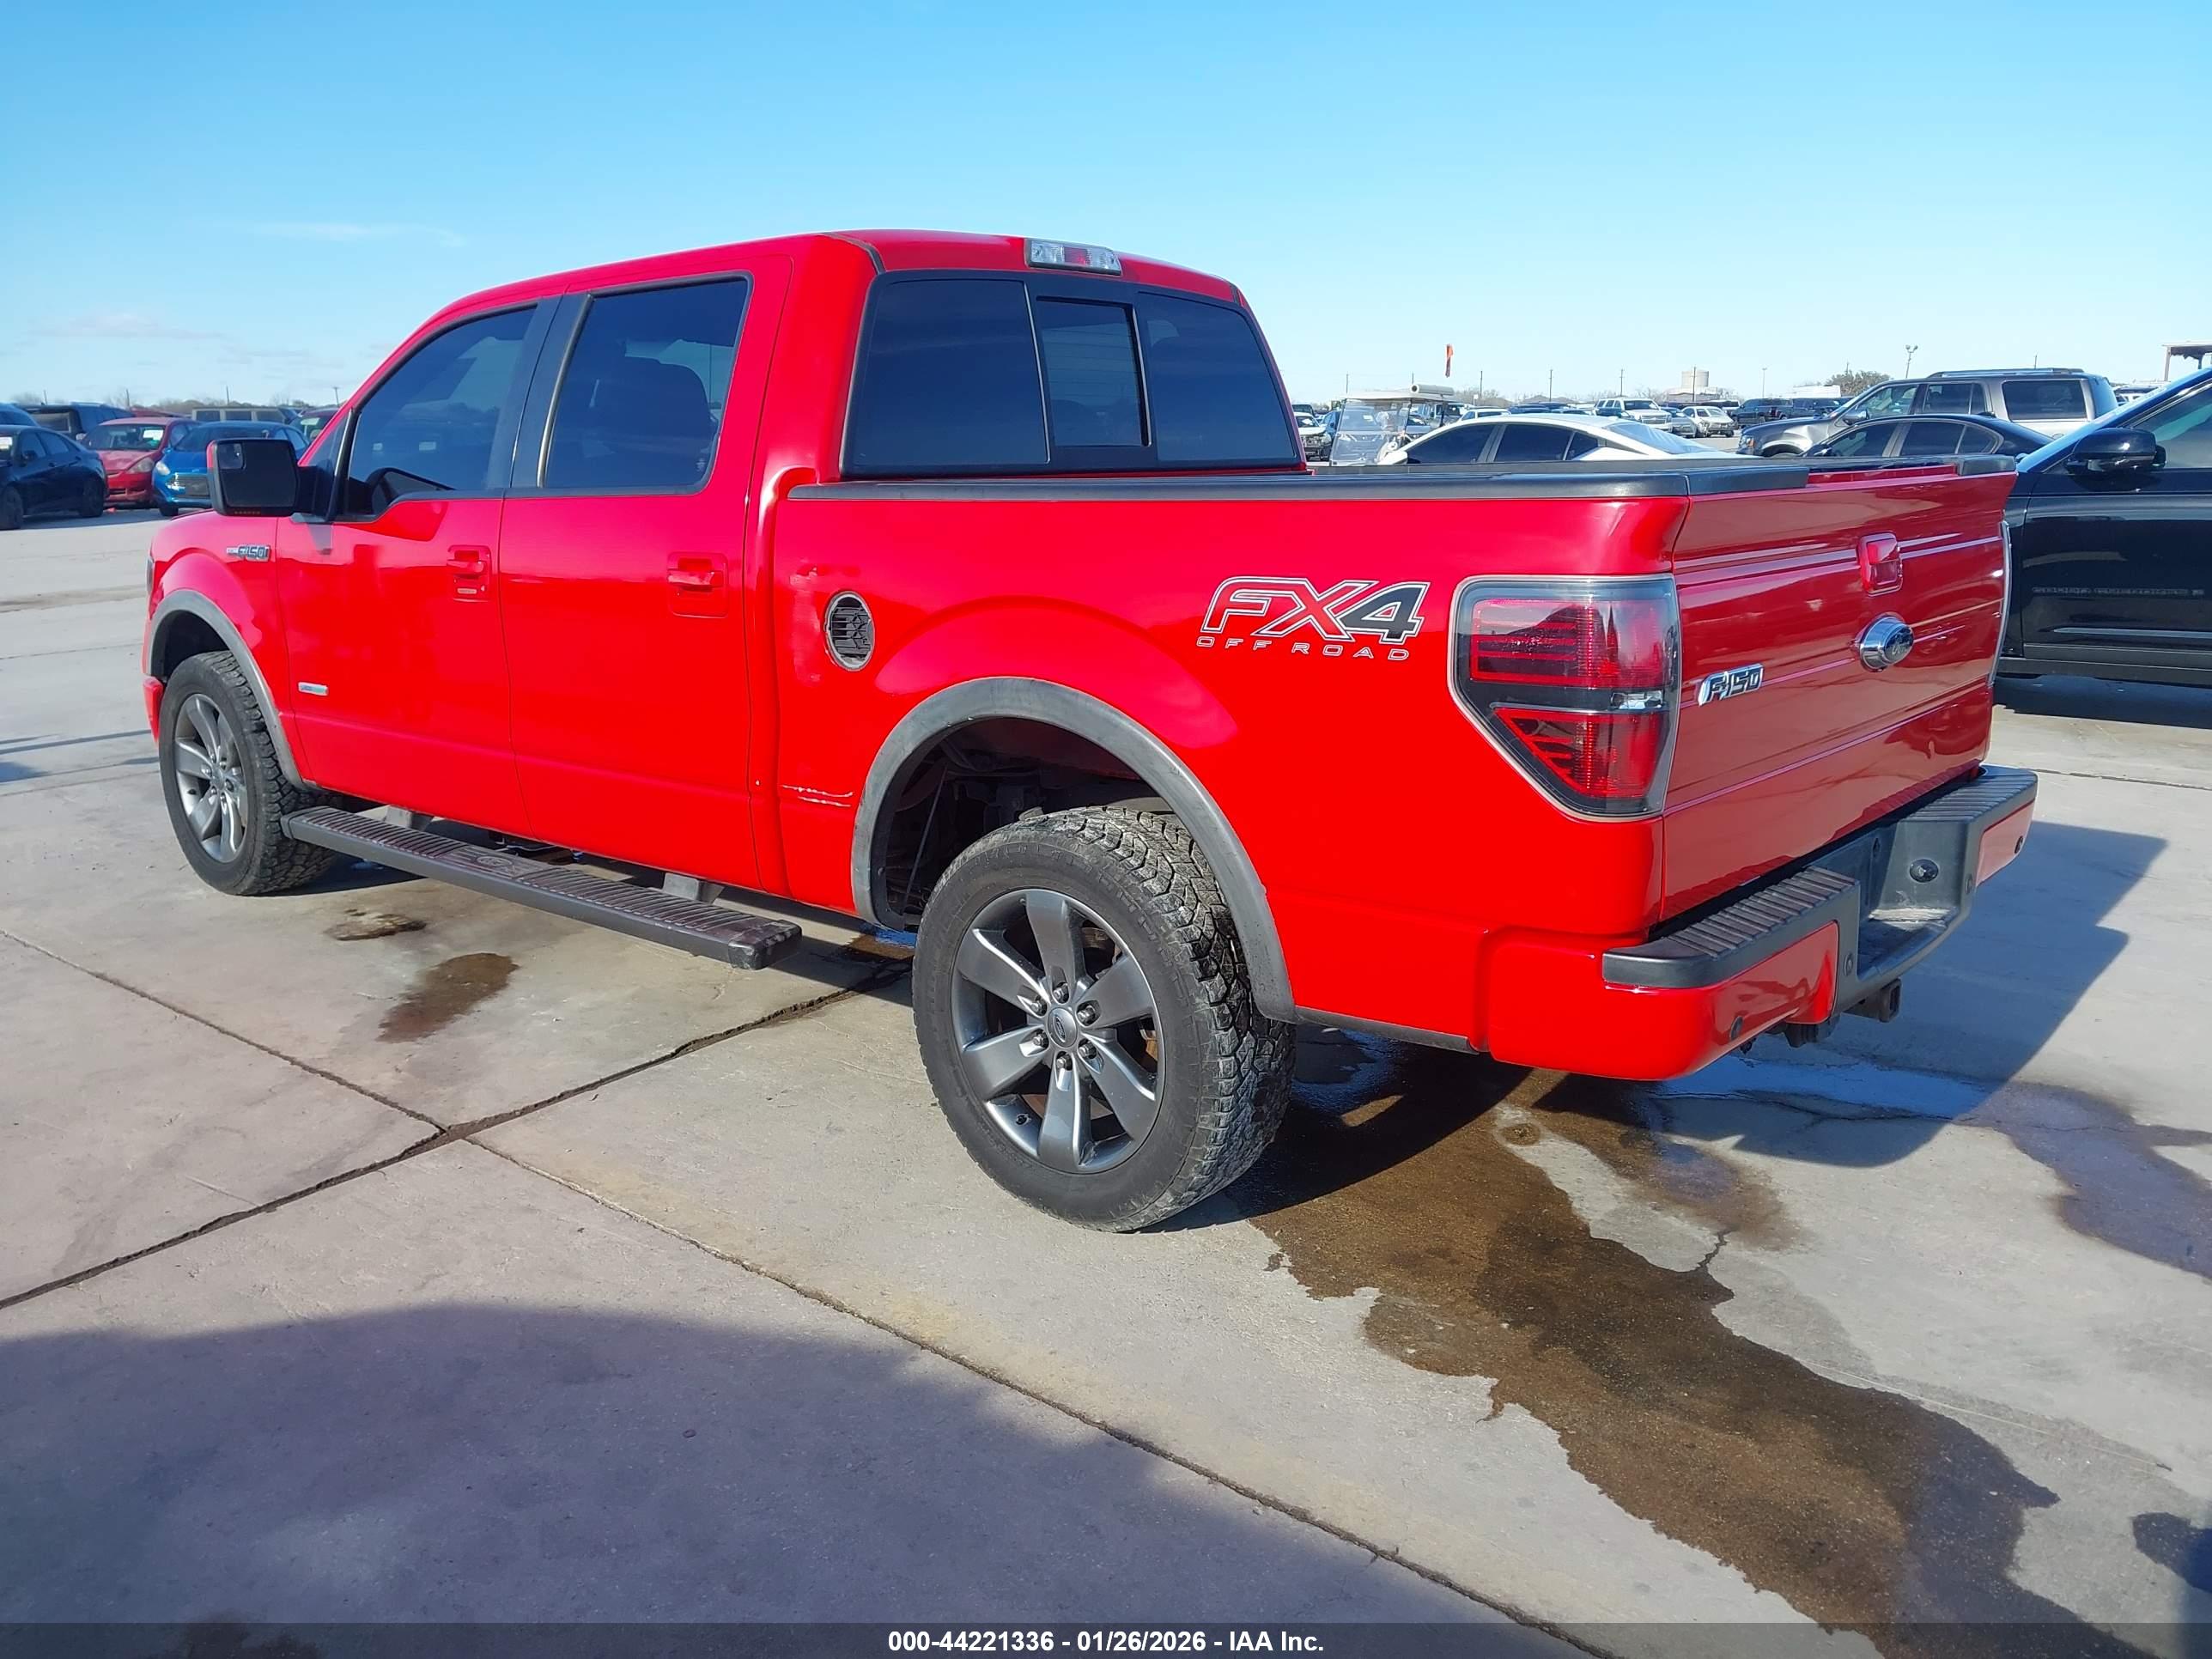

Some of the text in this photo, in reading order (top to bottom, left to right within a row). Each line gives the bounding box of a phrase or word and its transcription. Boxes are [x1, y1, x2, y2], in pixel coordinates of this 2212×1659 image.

[1201, 577, 1431, 644] FX4
[1196, 636, 1410, 660] OFF ROAD
